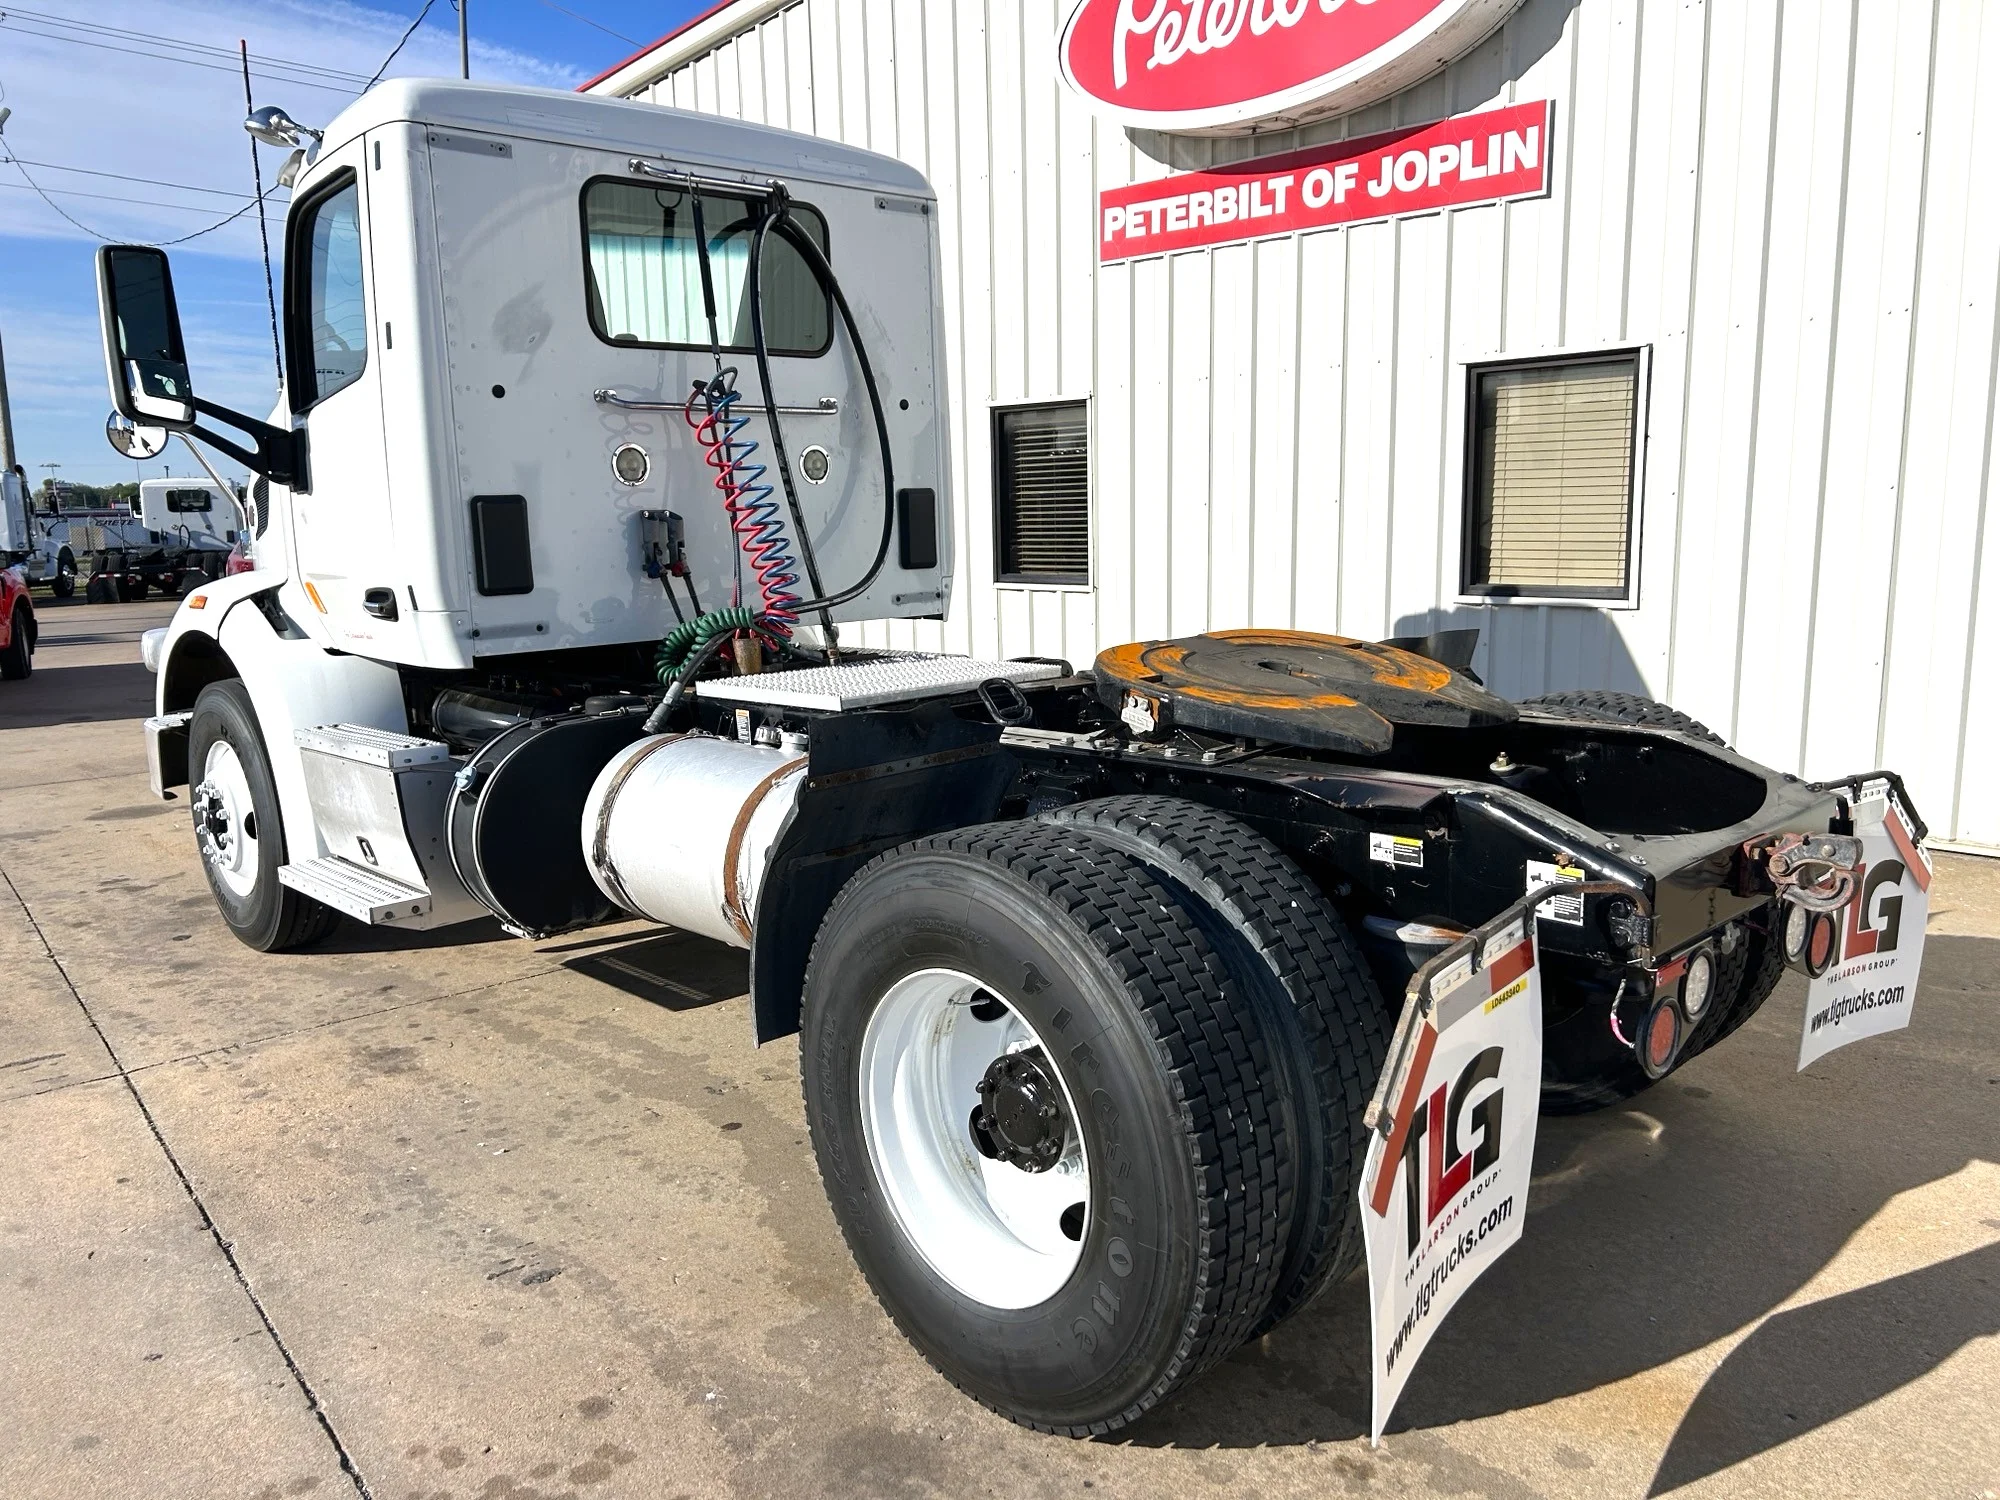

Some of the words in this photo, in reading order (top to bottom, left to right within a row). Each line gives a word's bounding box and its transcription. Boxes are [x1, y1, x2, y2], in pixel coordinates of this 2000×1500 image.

[1103, 175, 1294, 242] PETERBILT
[1302, 164, 1357, 208] OF
[1369, 126, 1540, 198] JOPLIN
[1810, 983, 1905, 1034] www.tlgtrucks.com
[1827, 974, 1838, 986] THE
[1838, 963, 1867, 981] LARSON
[1867, 958, 1896, 971] GROUP
[1385, 1194, 1514, 1378] www.tlgtrucks.com
[1404, 1260, 1421, 1288] THE
[1420, 1204, 1461, 1260] LARSON
[1462, 1172, 1500, 1208] GROUP
